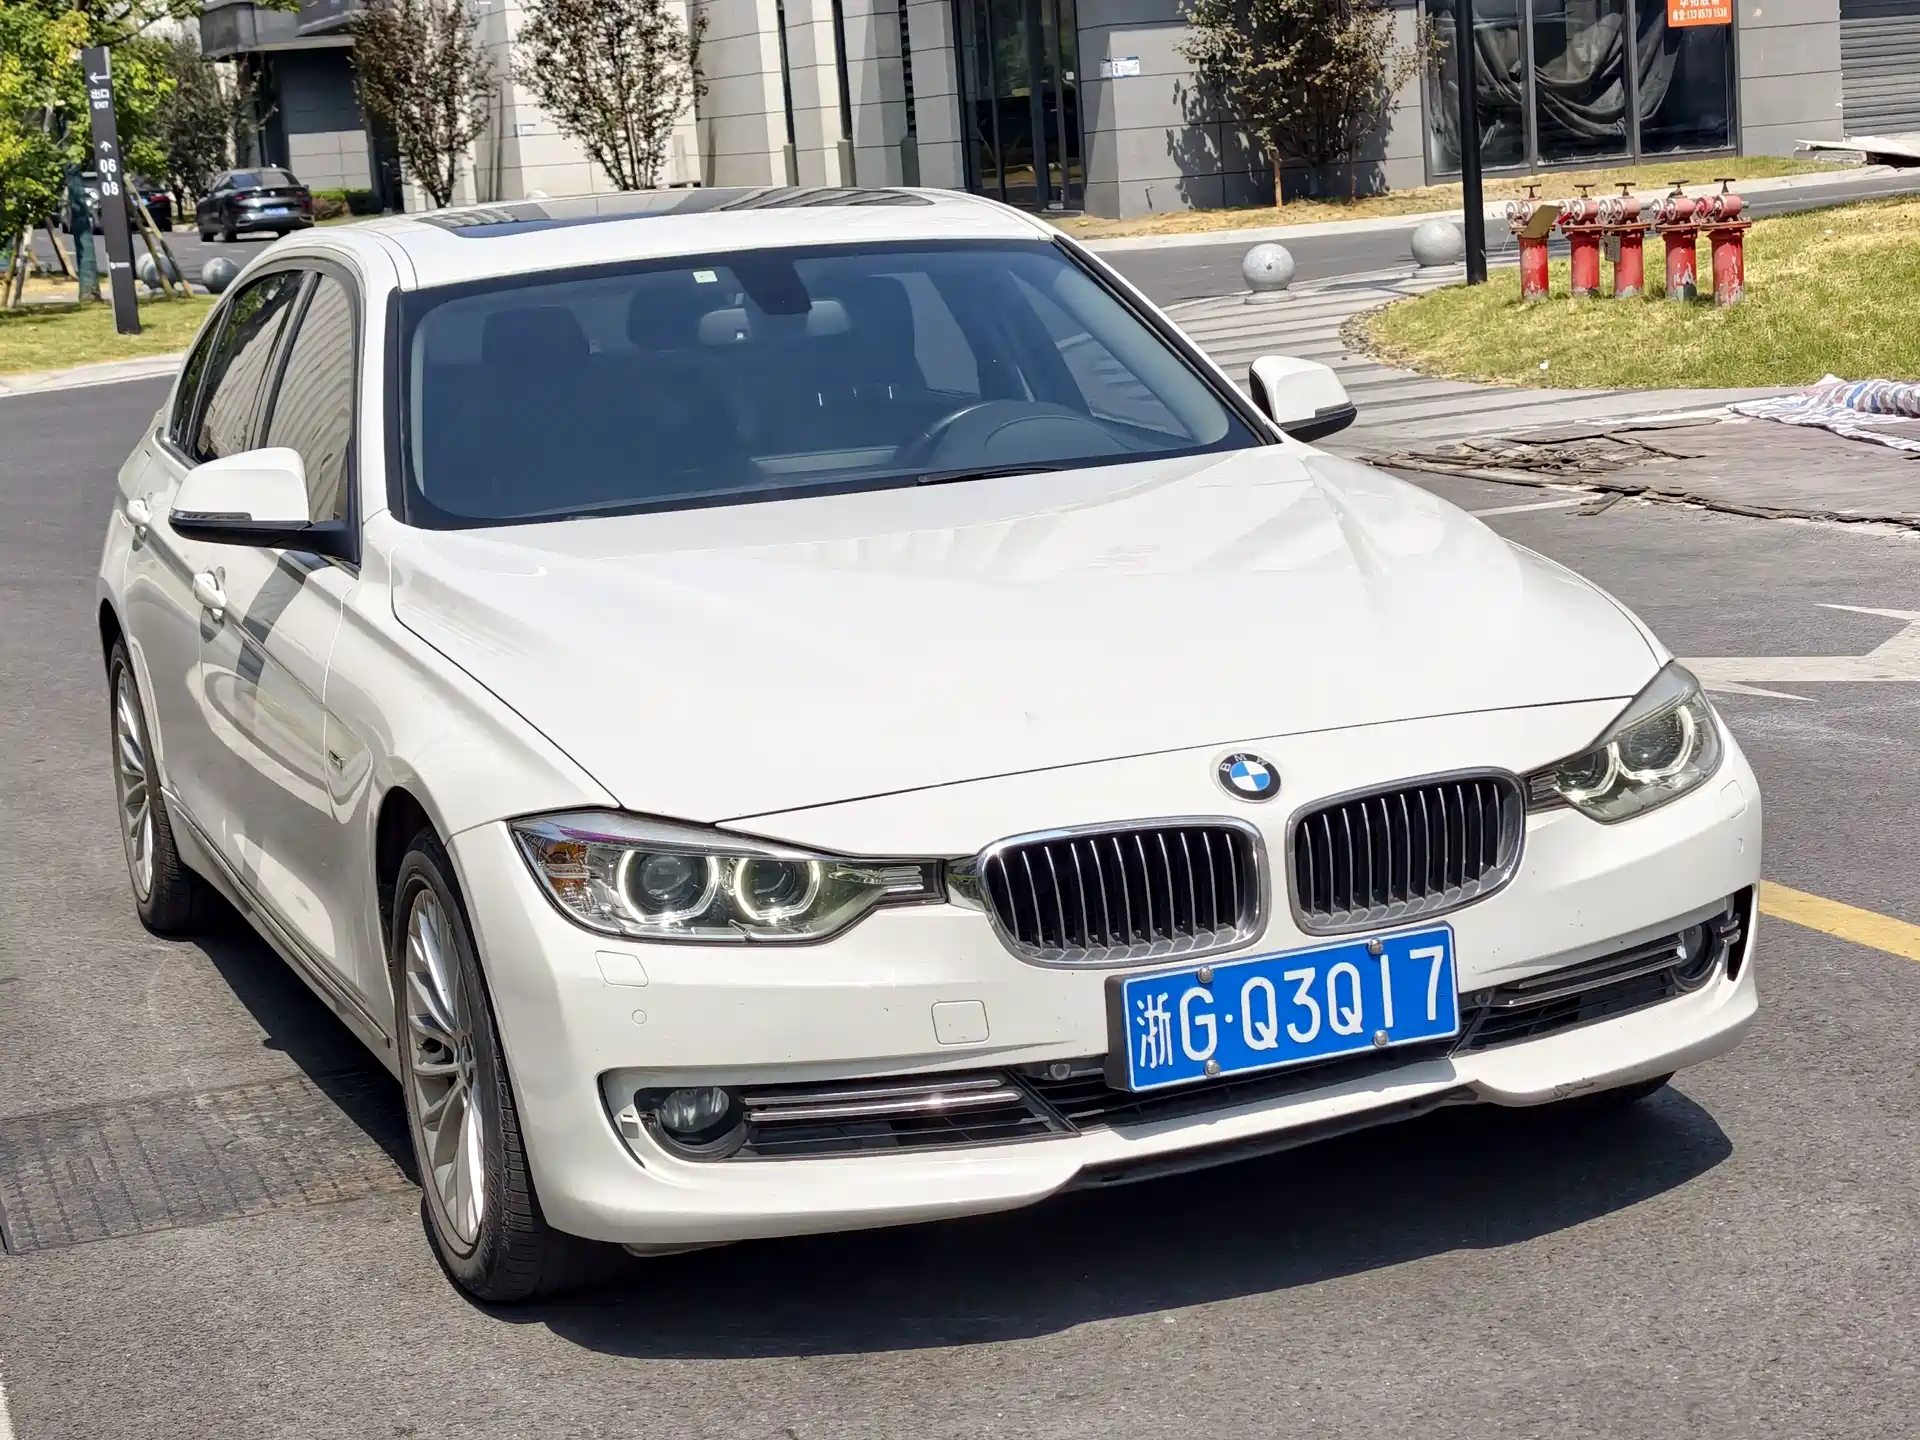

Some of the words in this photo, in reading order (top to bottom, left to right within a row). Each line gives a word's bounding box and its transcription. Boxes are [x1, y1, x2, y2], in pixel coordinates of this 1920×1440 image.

[90, 88, 110, 100] 出口
[100, 158, 117, 173] 06
[102, 181, 119, 196] 08
[1220, 753, 1269, 773] BMW
